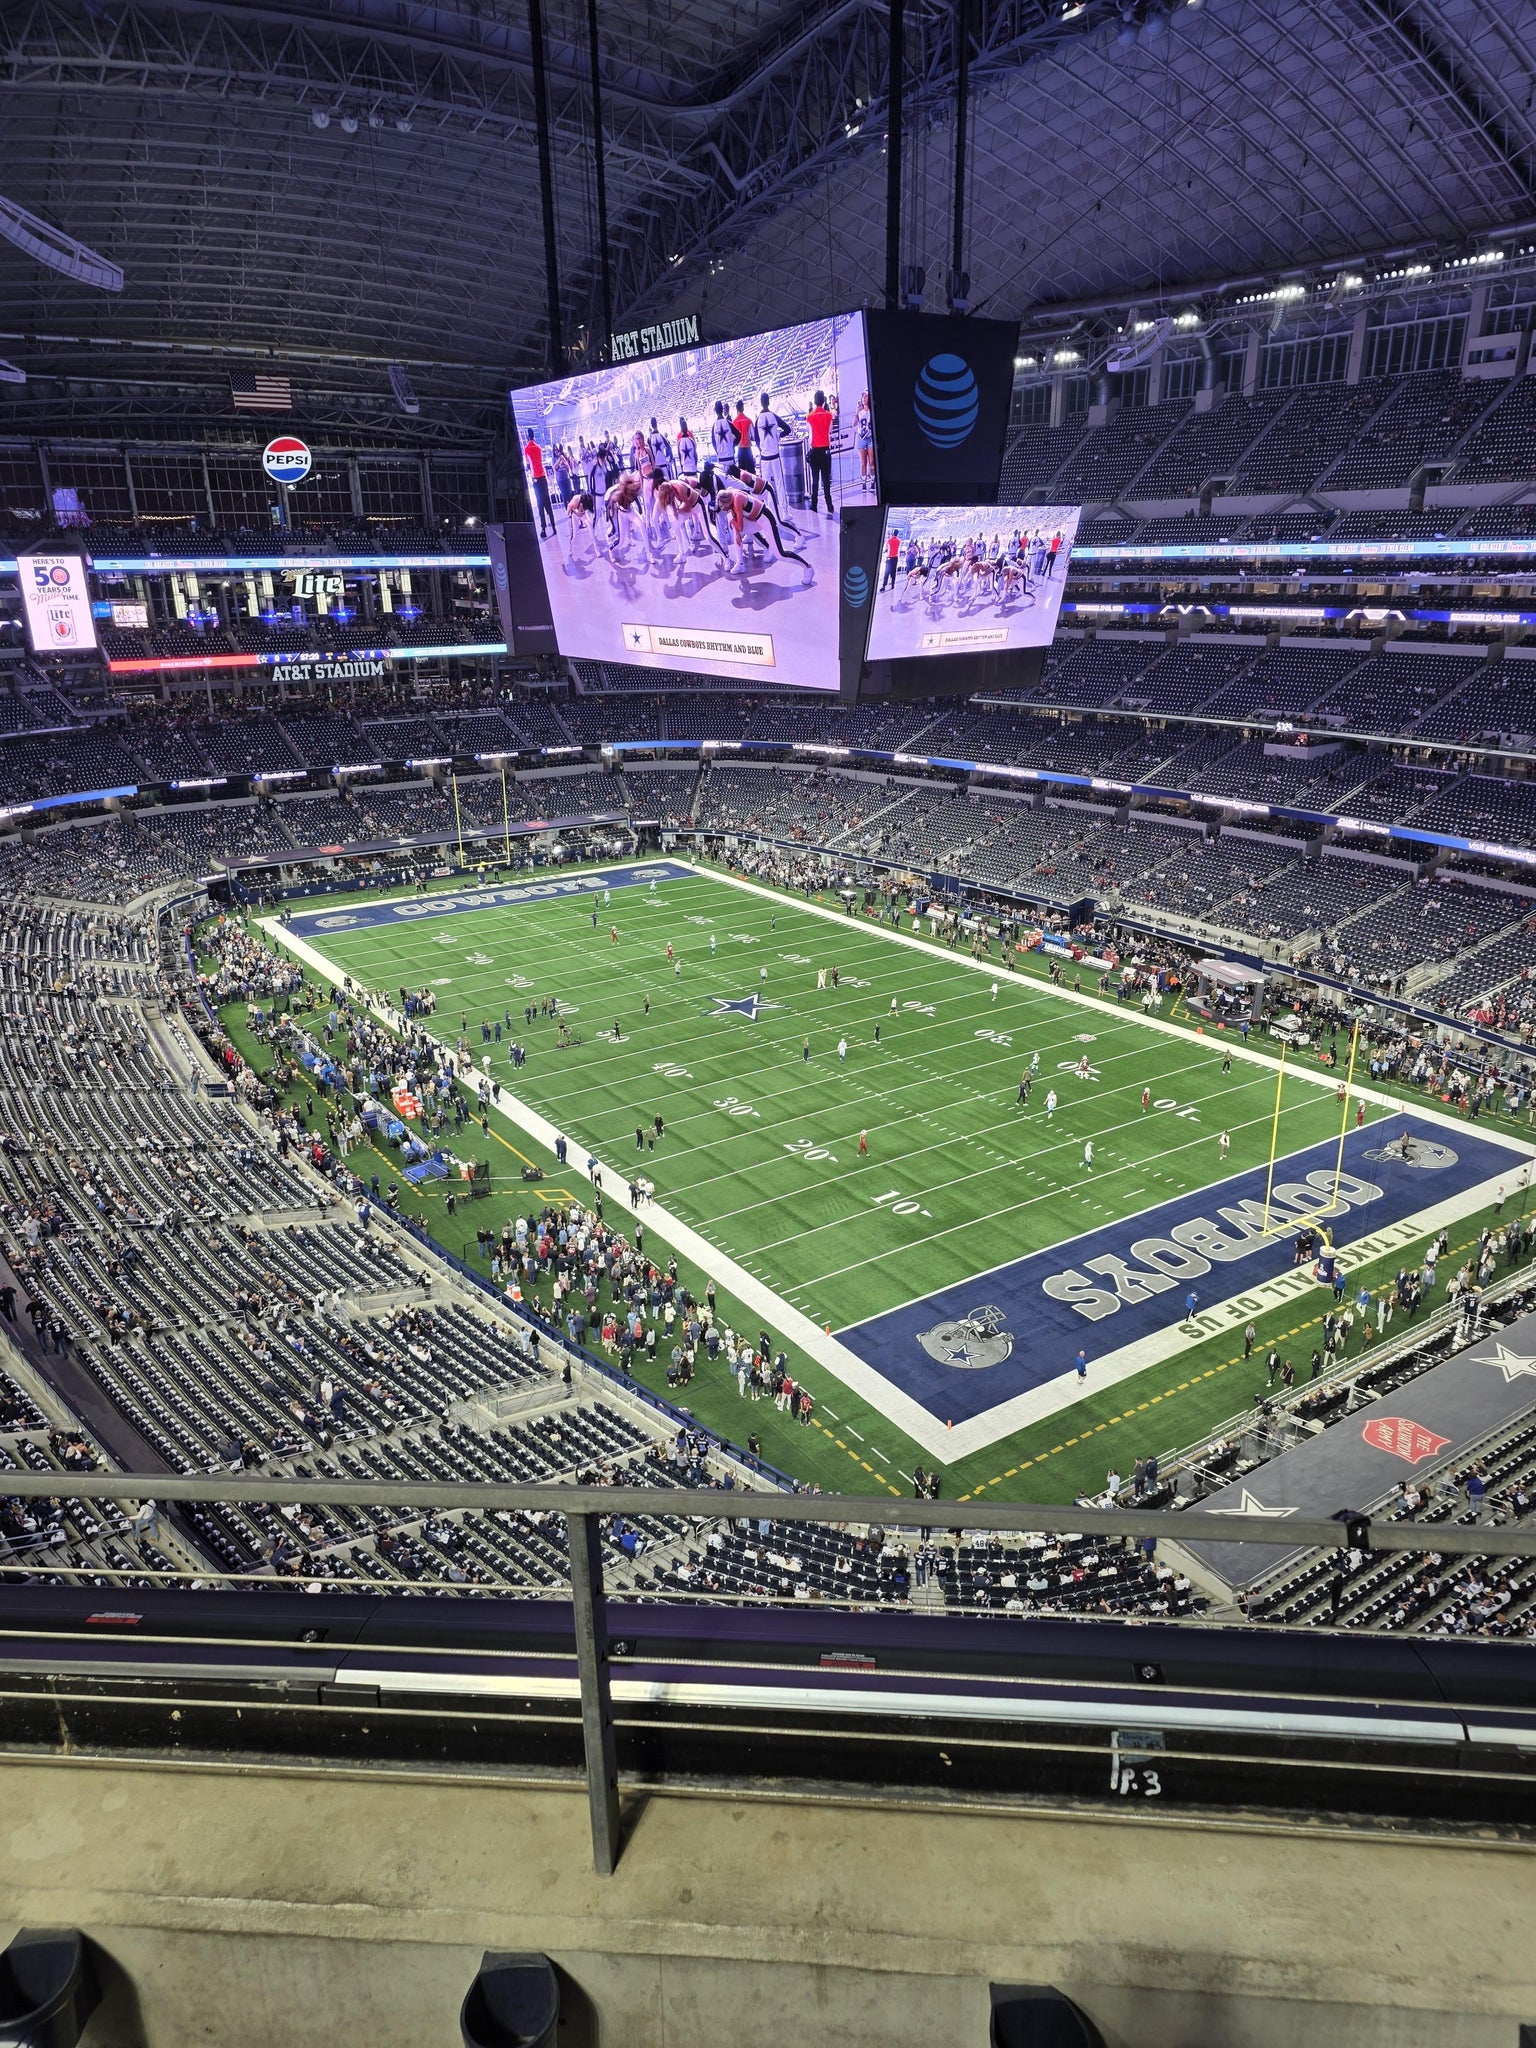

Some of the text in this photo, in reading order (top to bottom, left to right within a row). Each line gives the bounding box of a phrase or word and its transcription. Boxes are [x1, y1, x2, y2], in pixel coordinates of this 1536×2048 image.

[612, 315, 700, 361] AT&T STADIUM
[266, 455, 308, 465] PEPSI
[34, 566, 70, 586] 50
[292, 573, 343, 599] Lite
[50, 609, 70, 621] Lite
[658, 637, 764, 656] DALLAS COWBOYS RHYTHM AND BLUE
[272, 660, 385, 682] AT&T STADIUM
[1364, 822, 1390, 834] Mortgage
[393, 876, 609, 916] COWBOYS
[504, 974, 535, 988] 30
[651, 1062, 688, 1078] 40
[713, 1096, 754, 1116] 30
[1153, 1098, 1201, 1118] 10
[783, 1138, 831, 1161] 20
[870, 1189, 921, 1215] 10
[1042, 1170, 1384, 1321] COWBOYS
[1178, 1222, 1425, 1339] IT TAKE ALL OF US
[1376, 1421, 1395, 1449] ARMY
[1396, 1420, 1415, 1459] SALVATION
[1416, 1434, 1432, 1452] THE
